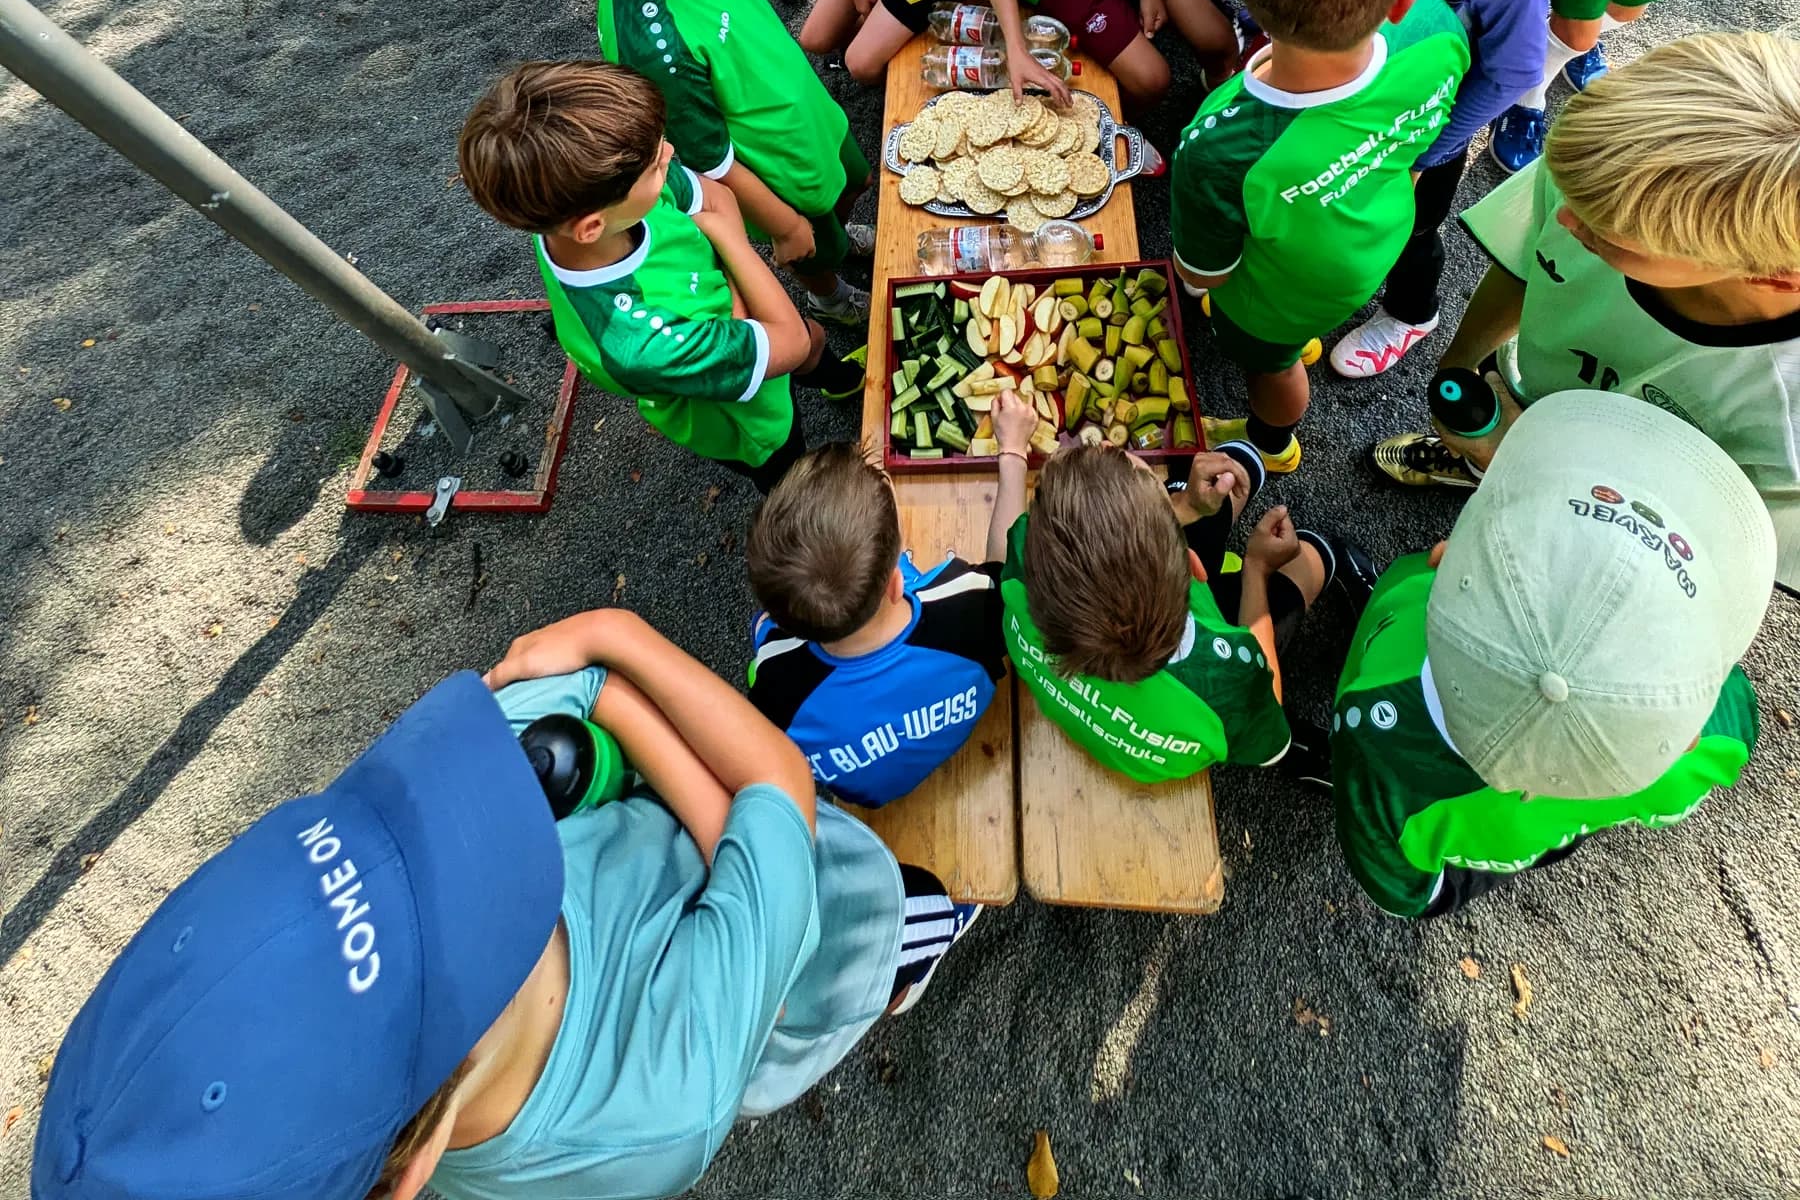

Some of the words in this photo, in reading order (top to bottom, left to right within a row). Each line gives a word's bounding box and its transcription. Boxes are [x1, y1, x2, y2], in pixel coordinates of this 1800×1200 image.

[718, 11, 730, 44] JAKO
[1568, 498, 1697, 599] MARVEL
[828, 685, 977, 774] BLAU-WEISS
[1010, 614, 1201, 756] Fooall-Fusion
[296, 816, 342, 864] ON
[320, 858, 381, 994] COME
